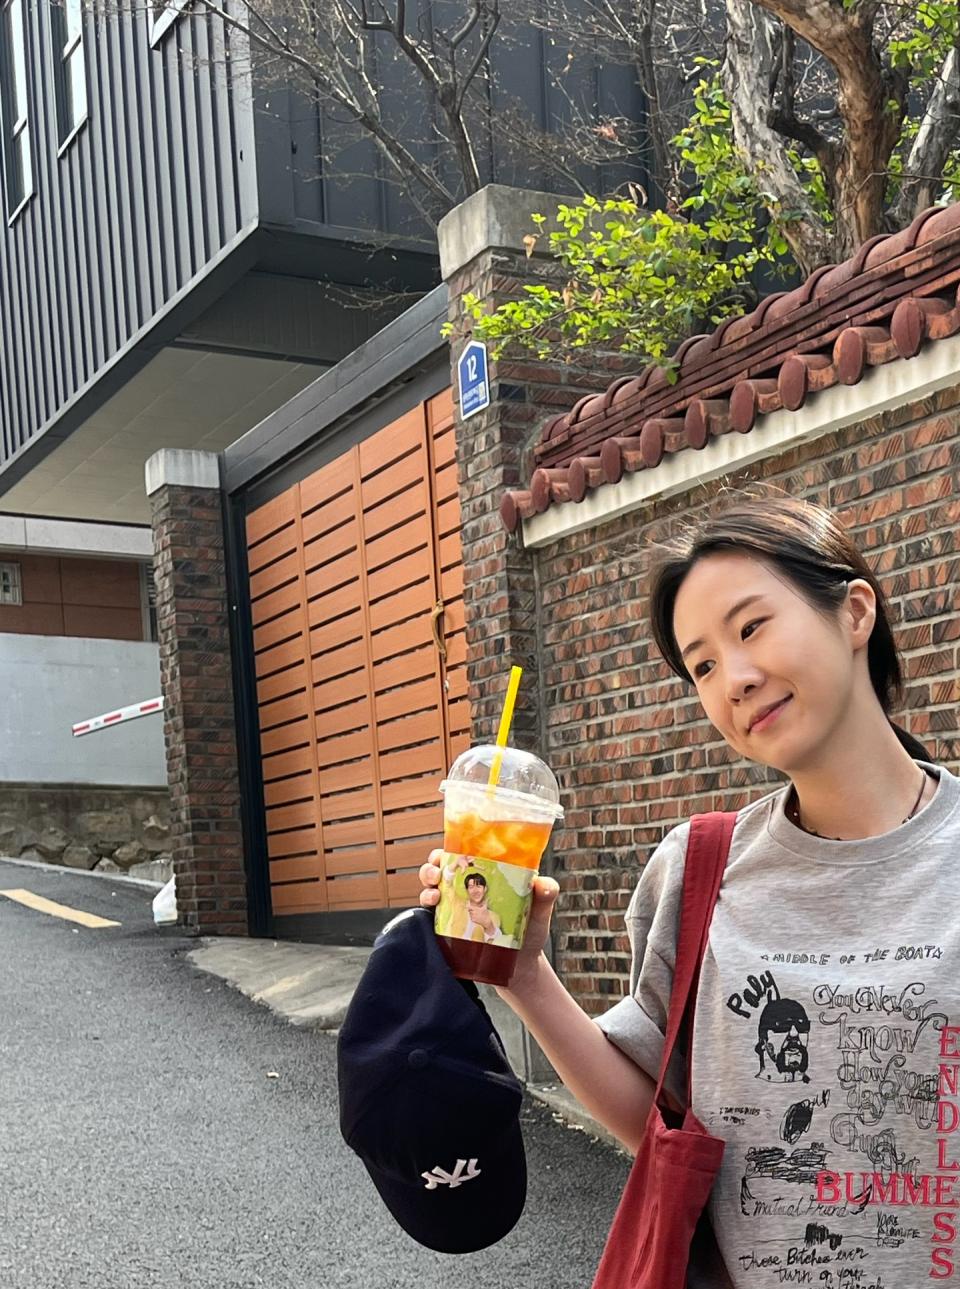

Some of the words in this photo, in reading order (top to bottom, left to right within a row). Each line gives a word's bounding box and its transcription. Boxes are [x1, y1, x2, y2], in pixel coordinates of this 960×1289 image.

[467, 355, 478, 382] 12
[772, 953, 831, 966] MIDDLE
[839, 955, 856, 965] OF
[864, 948, 890, 962] THE
[894, 945, 935, 961] BOAT
